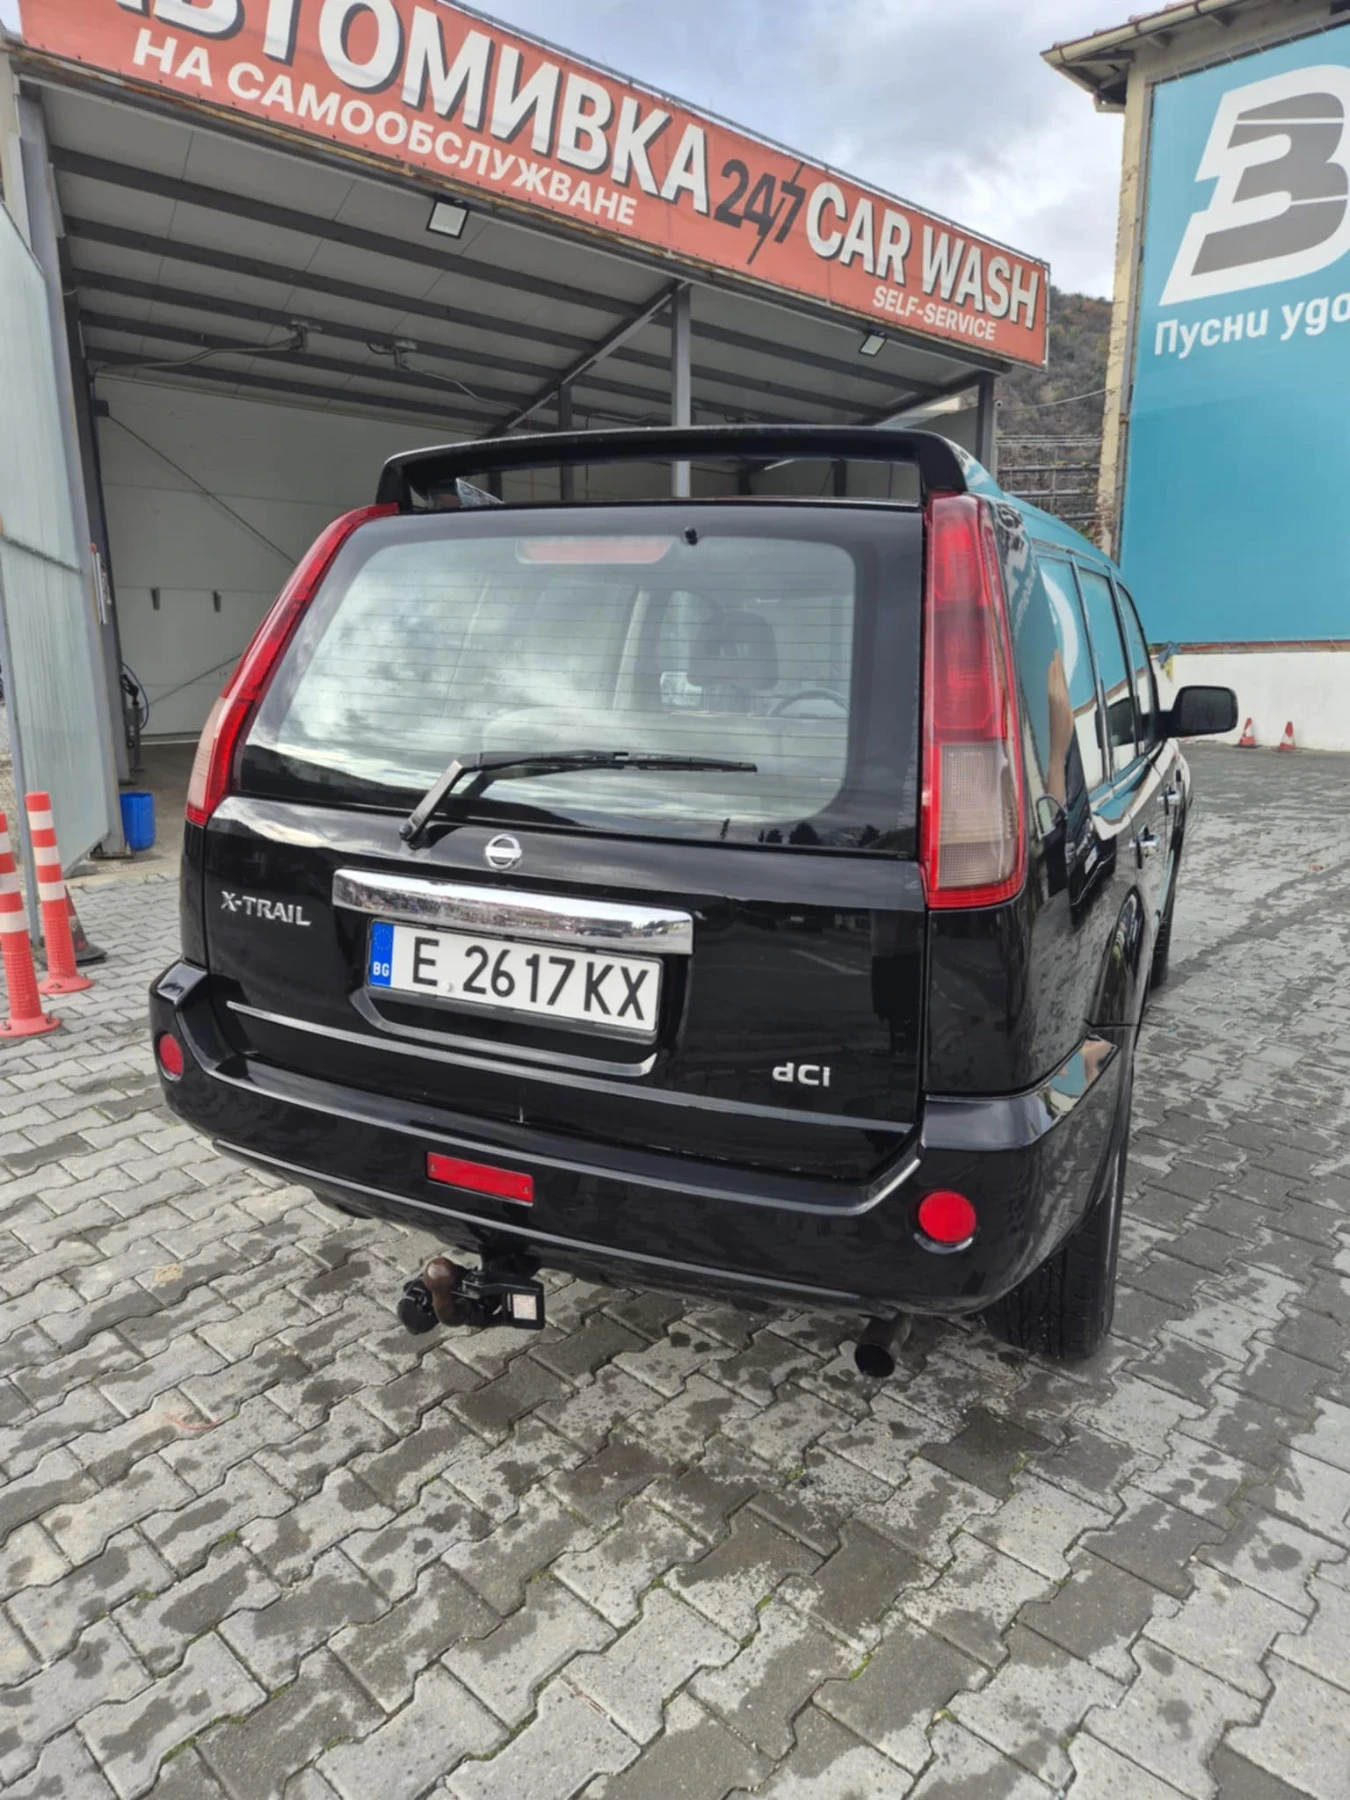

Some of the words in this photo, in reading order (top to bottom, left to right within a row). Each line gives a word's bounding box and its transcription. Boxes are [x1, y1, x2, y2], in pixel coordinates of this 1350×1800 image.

[115, 0, 712, 217] ОМИВКА
[133, 28, 213, 87] НА
[227, 62, 638, 226] САМООБСЛУЖВАНЕ
[806, 181, 912, 286] CAR
[921, 224, 1040, 331] WASH
[872, 285, 997, 342] SELF-SERVICE
[1154, 309, 1269, 359] Пусни
[221, 890, 312, 926] X-TRAIL
[372, 962, 390, 977] BG
